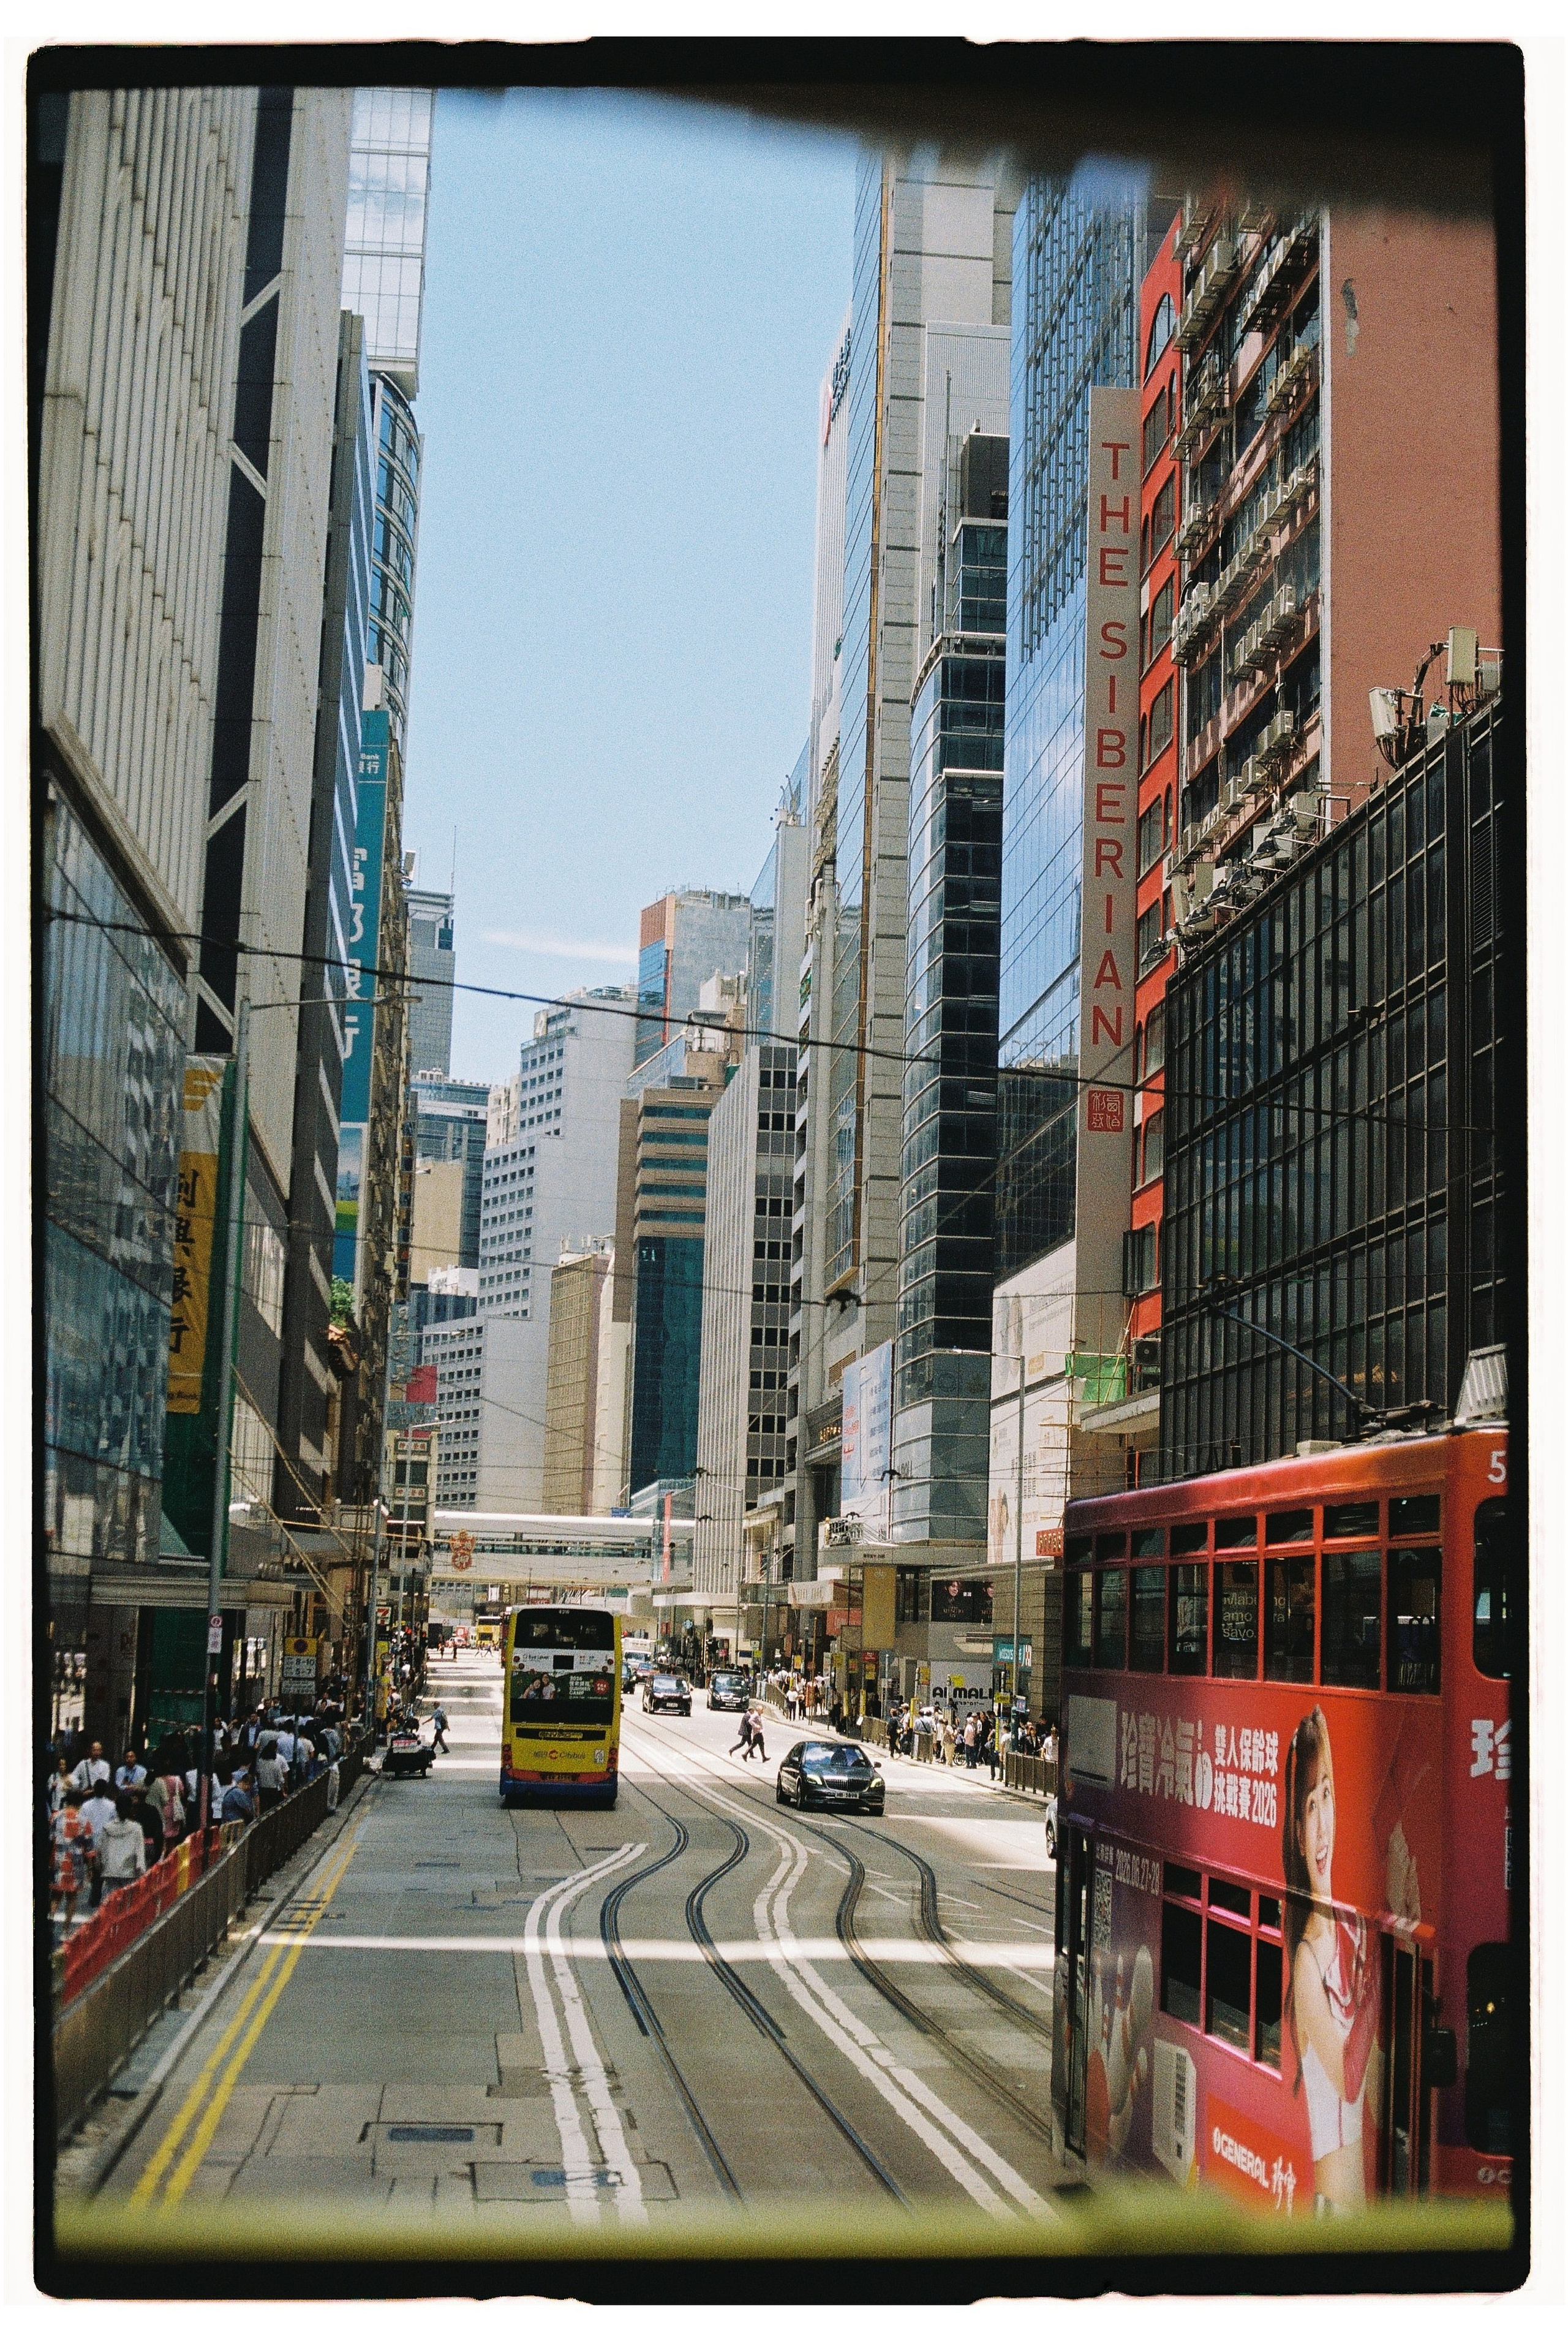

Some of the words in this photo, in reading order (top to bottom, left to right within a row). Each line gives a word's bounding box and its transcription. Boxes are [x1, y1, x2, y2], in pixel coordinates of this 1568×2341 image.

[1099, 442, 1130, 587] THE
[1091, 621, 1128, 1047] SIBERIAN
[1215, 1724, 1278, 1776] 雙人保齡球
[1214, 1771, 1251, 1820] 挑戰賽
[1252, 1779, 1277, 1828] 2026
[1221, 2133, 1269, 2189] GENERAL
